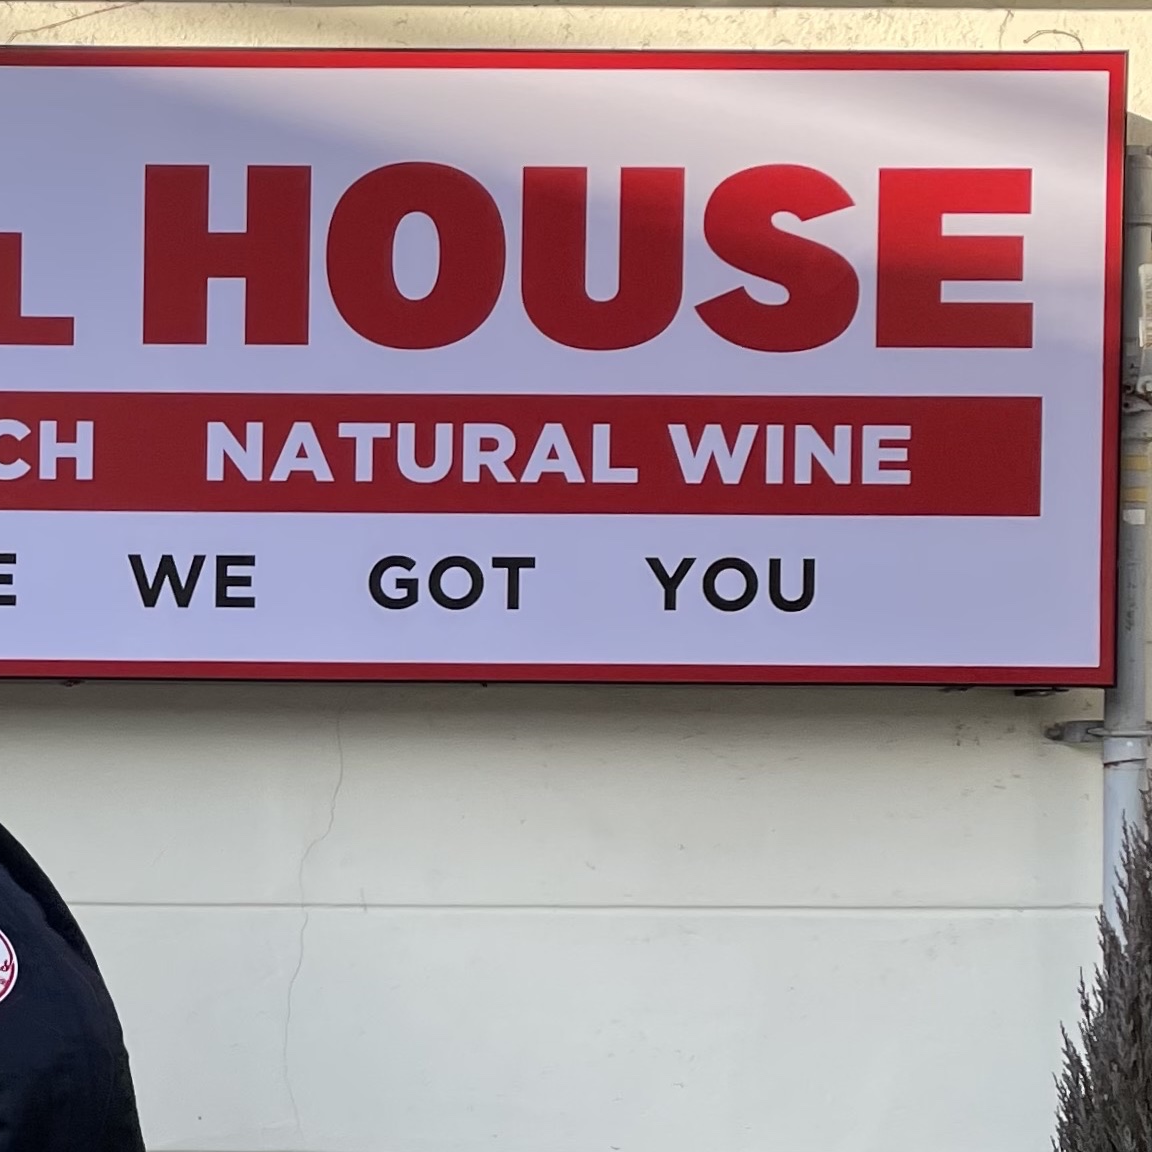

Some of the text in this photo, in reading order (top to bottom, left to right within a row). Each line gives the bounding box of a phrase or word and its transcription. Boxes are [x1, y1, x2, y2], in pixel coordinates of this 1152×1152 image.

[142, 162, 1034, 354] HOUSE
[206, 421, 638, 484] NATURAL
[667, 424, 912, 485] WINE
[128, 554, 256, 609] WE
[368, 555, 536, 611] GOT
[646, 557, 816, 613] YOU
